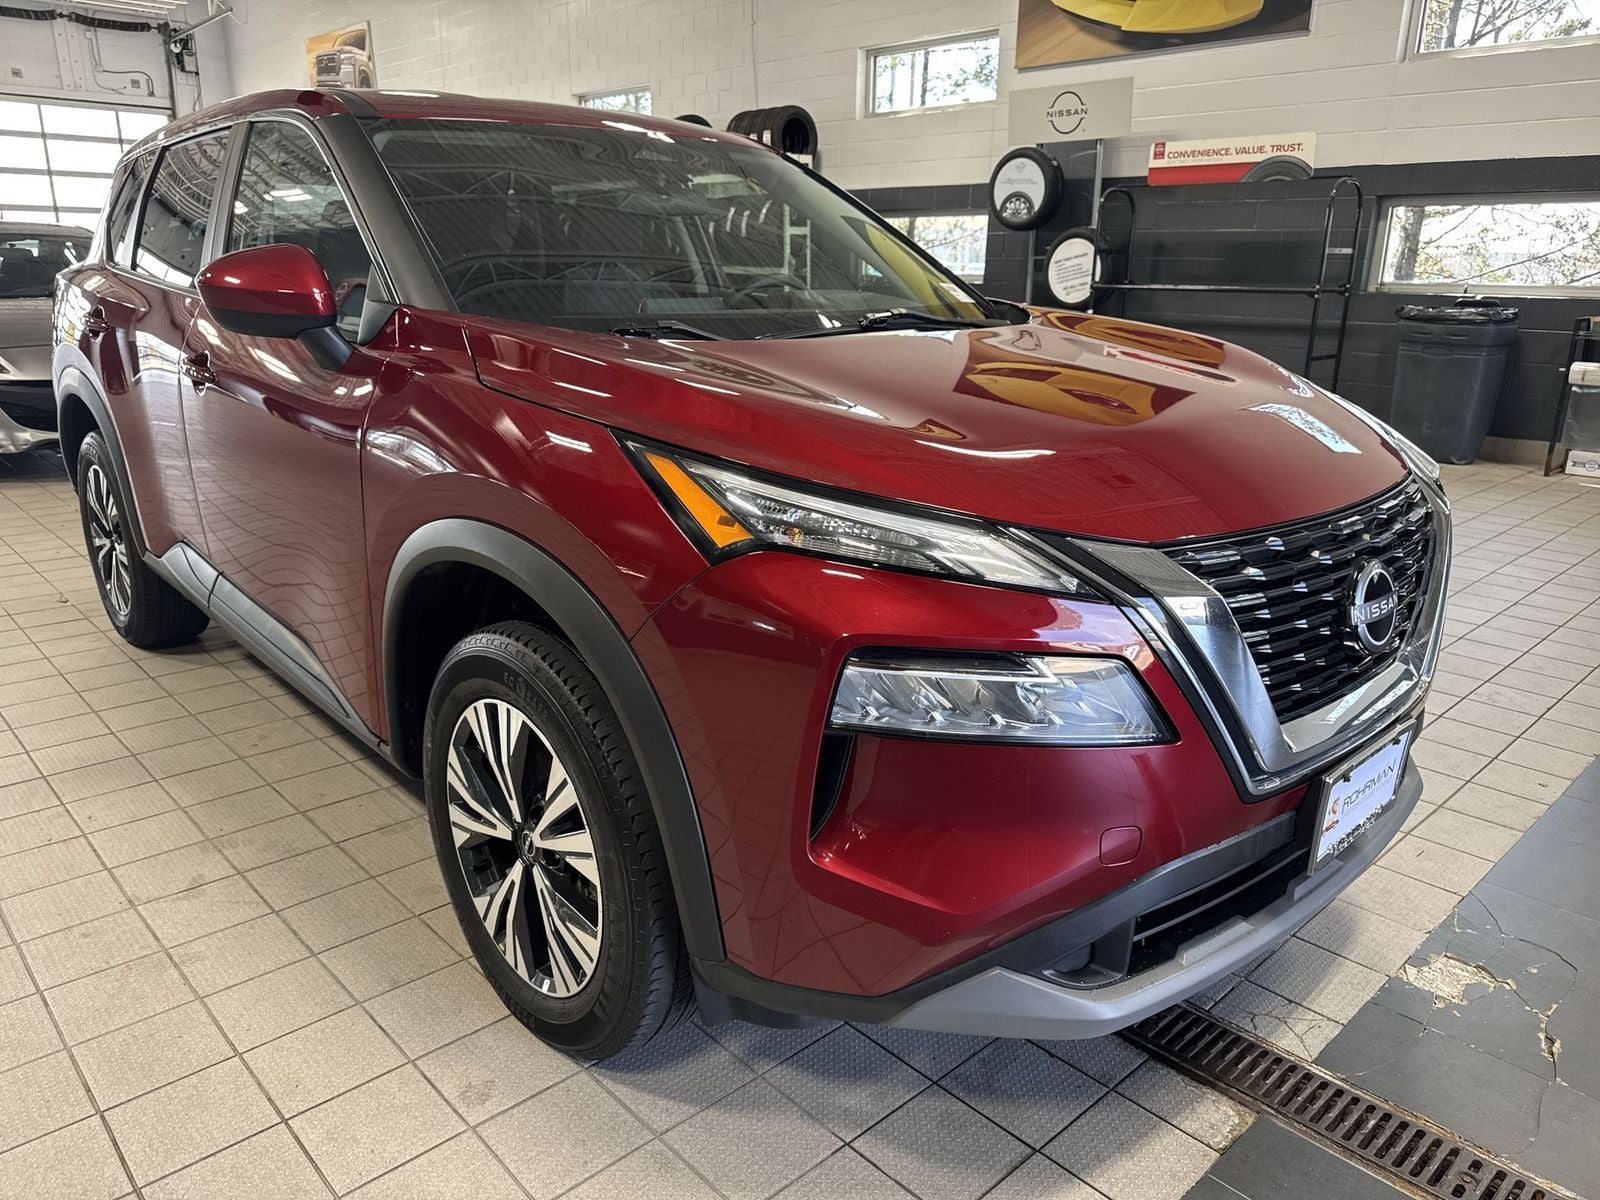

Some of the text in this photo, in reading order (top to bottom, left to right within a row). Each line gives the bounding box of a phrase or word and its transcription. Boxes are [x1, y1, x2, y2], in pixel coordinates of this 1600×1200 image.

[1046, 107, 1088, 118] NISSAN
[1166, 147, 1232, 160] CONVENIENCE.
[1234, 145, 1268, 155] VALUE.
[1270, 143, 1304, 153] TRUST.
[1353, 593, 1398, 623] NISSAN
[1341, 758, 1397, 815] ROHRMAN
